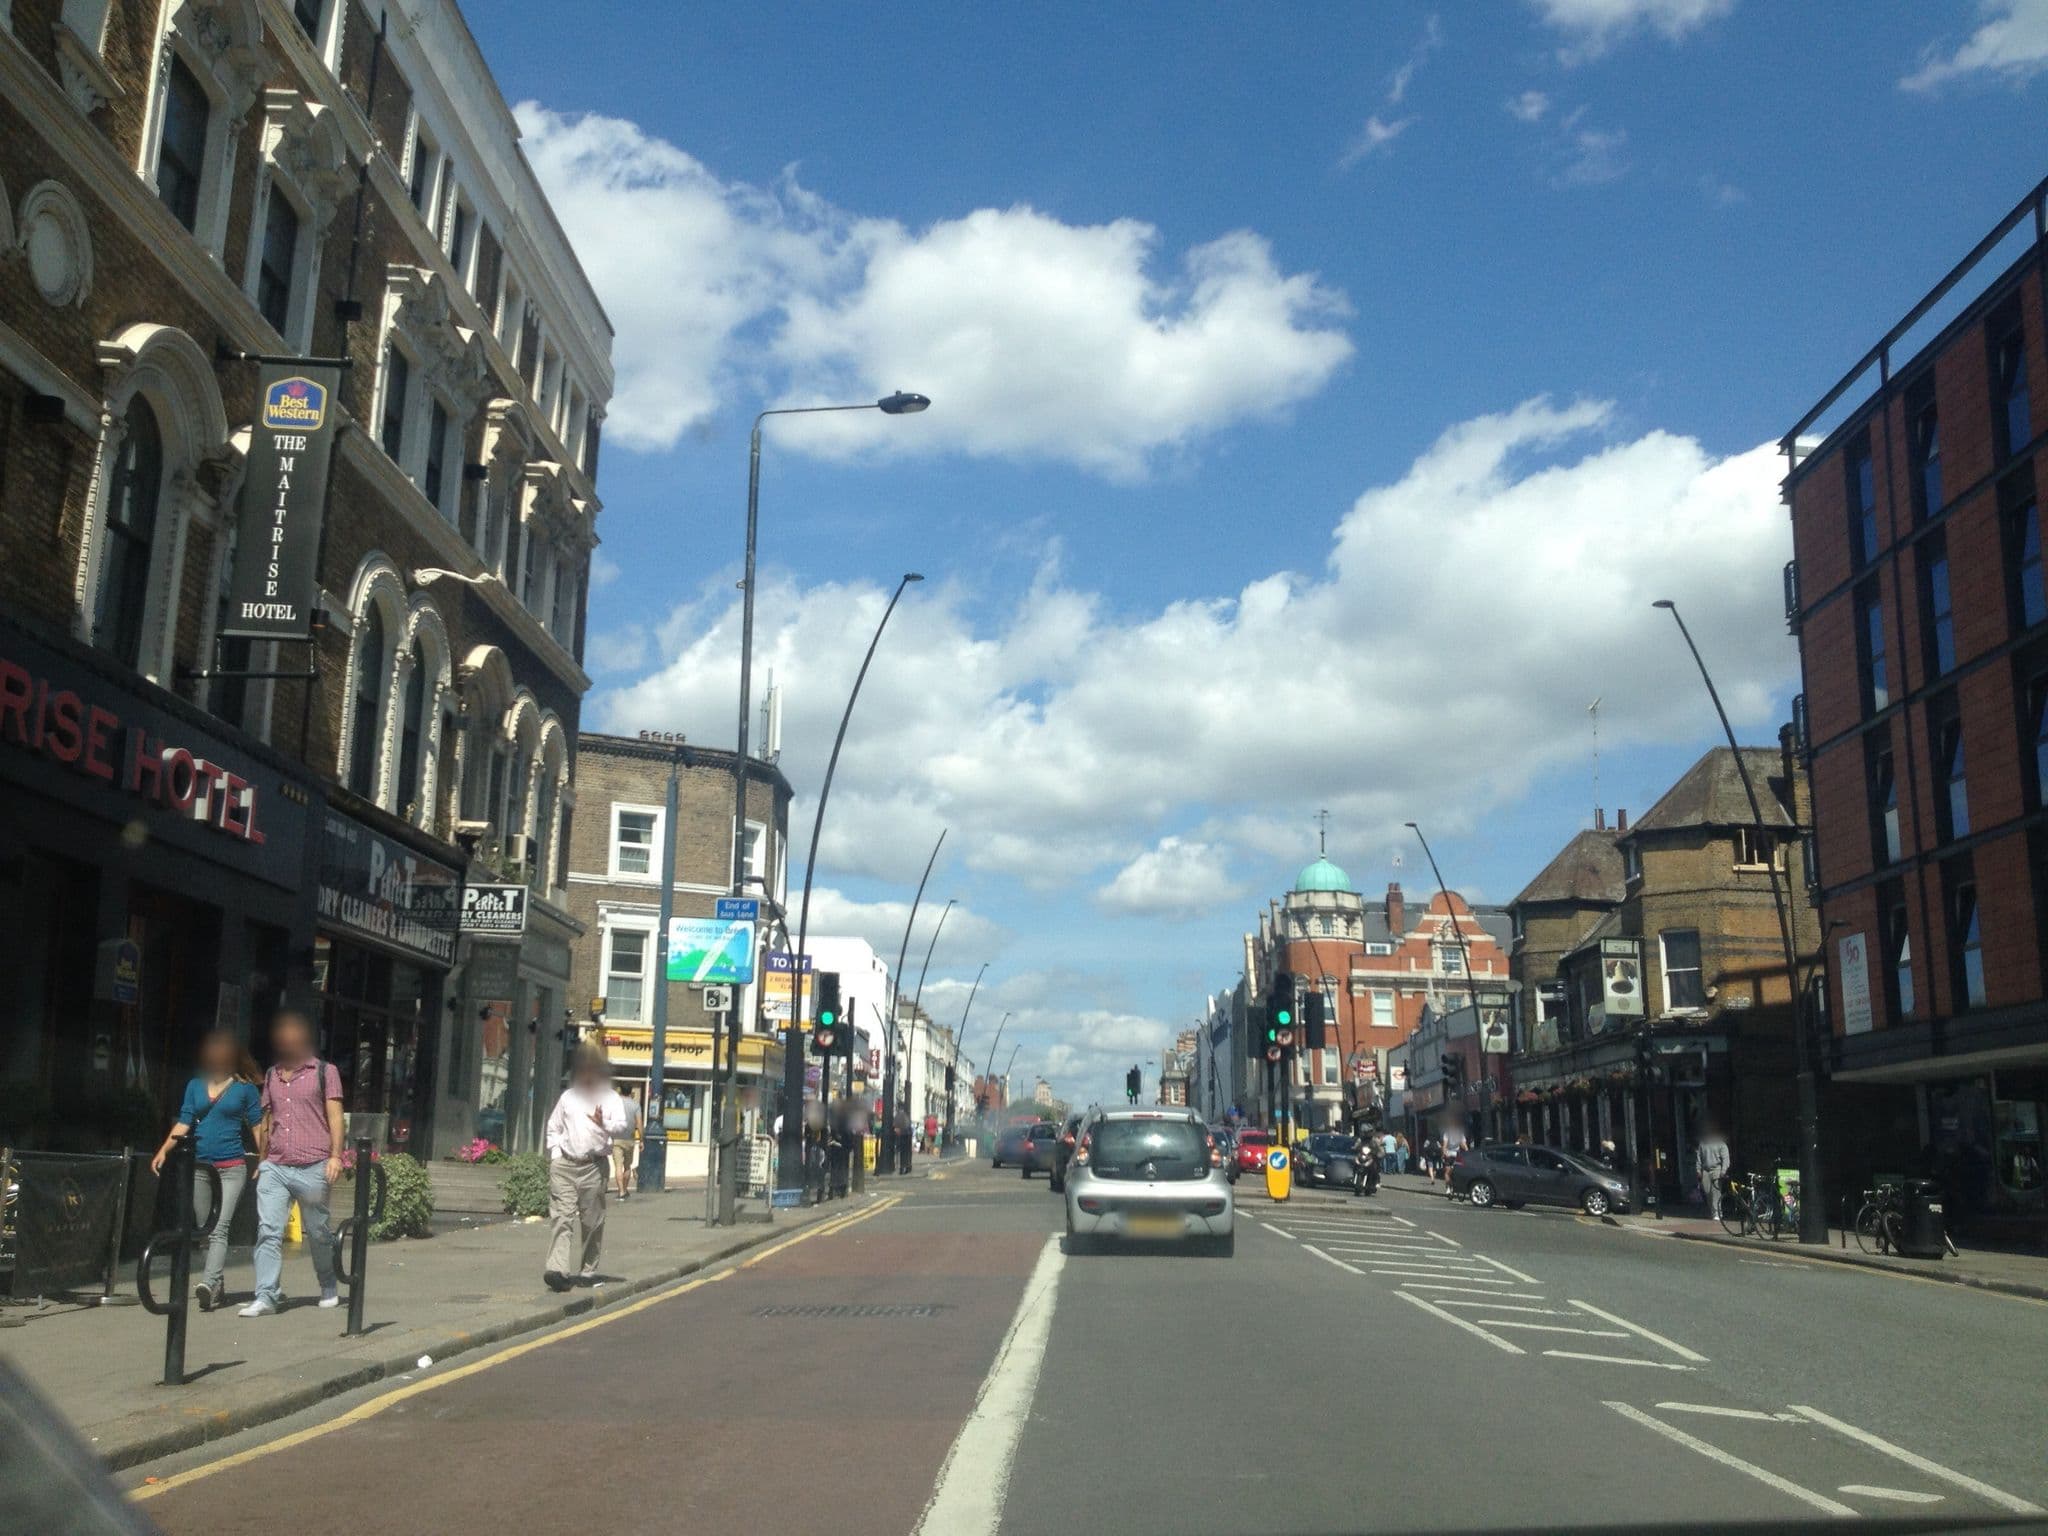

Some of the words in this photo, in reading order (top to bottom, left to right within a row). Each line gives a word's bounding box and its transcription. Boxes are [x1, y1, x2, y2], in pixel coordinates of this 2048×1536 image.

[281, 395, 309, 408] Best
[268, 404, 320, 420] Western
[274, 435, 307, 450] THE
[264, 456, 295, 596] MAITRISE
[241, 602, 297, 621] HOTEL
[132, 727, 267, 845] HOTEL
[463, 888, 519, 911] PERFECT
[725, 901, 740, 910] End
[742, 902, 751, 910] of
[317, 883, 340, 918] DRY
[341, 893, 388, 937] CLEANERS
[476, 911, 521, 920] CLEANERS
[771, 957, 788, 968] TO
[621, 1040, 653, 1052] Mon
[670, 1043, 704, 1056] Shop
